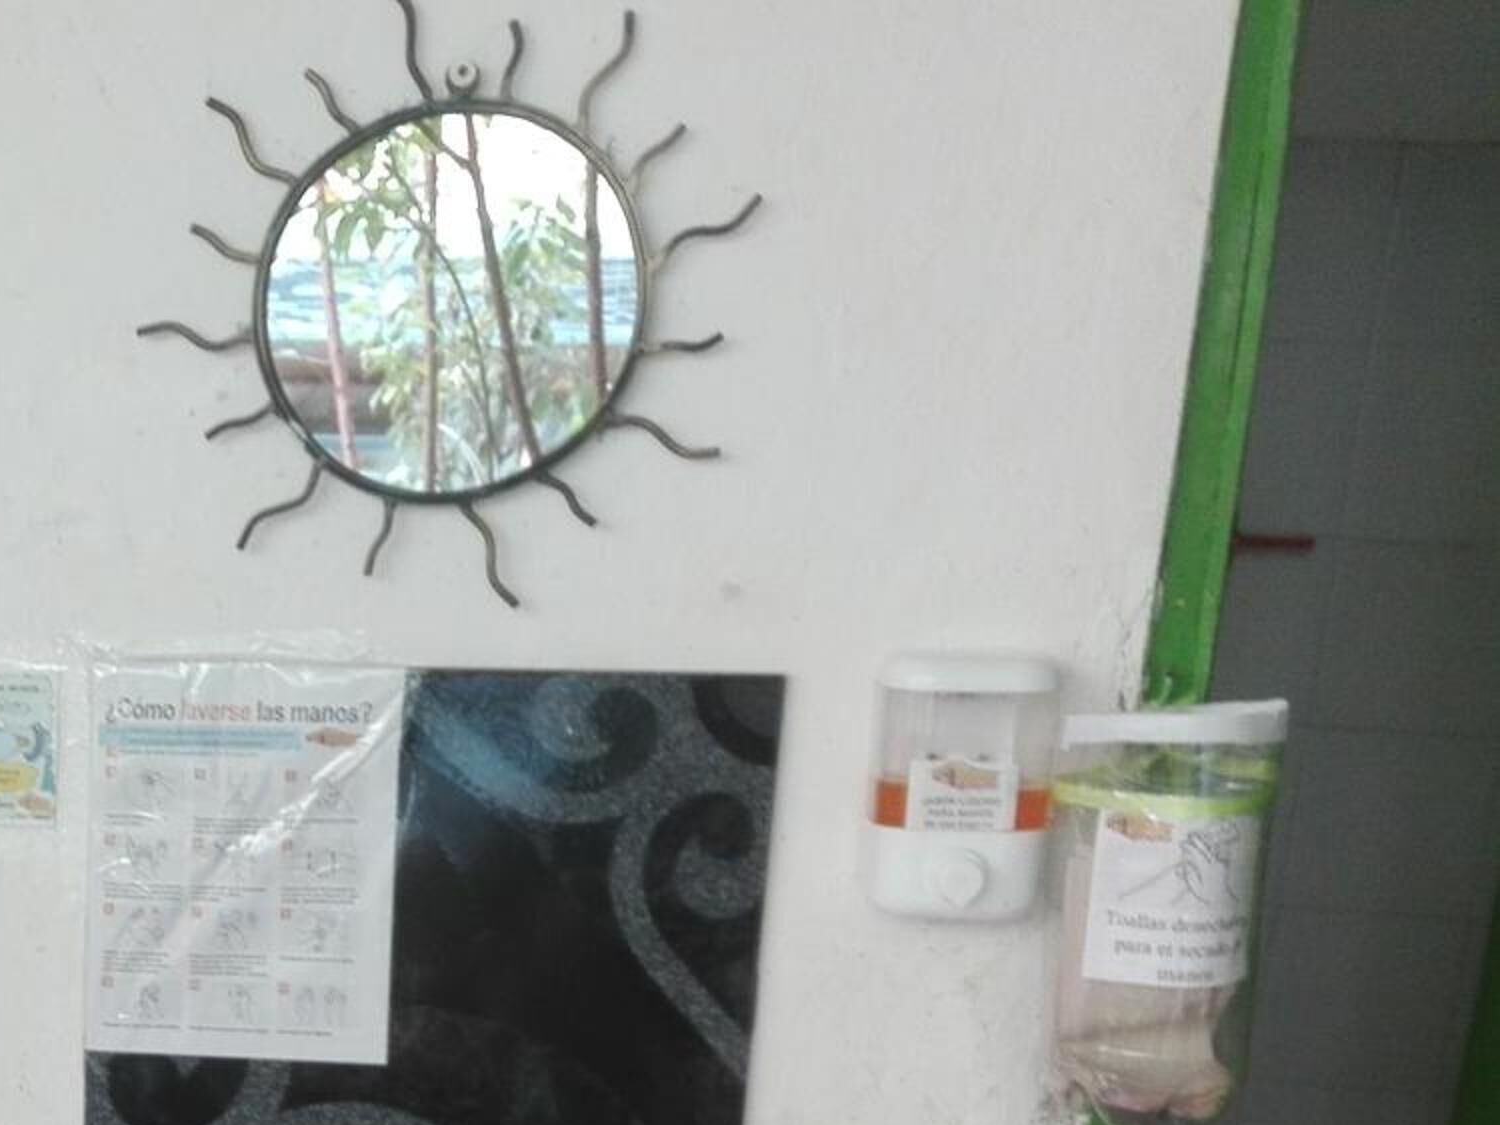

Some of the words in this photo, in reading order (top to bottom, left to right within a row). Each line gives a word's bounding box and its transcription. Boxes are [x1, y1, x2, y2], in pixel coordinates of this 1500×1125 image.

[104, 697, 176, 724] ¿Cómo
[257, 699, 285, 722] las
[290, 701, 373, 724] manos?
[1114, 940, 1152, 957] para
